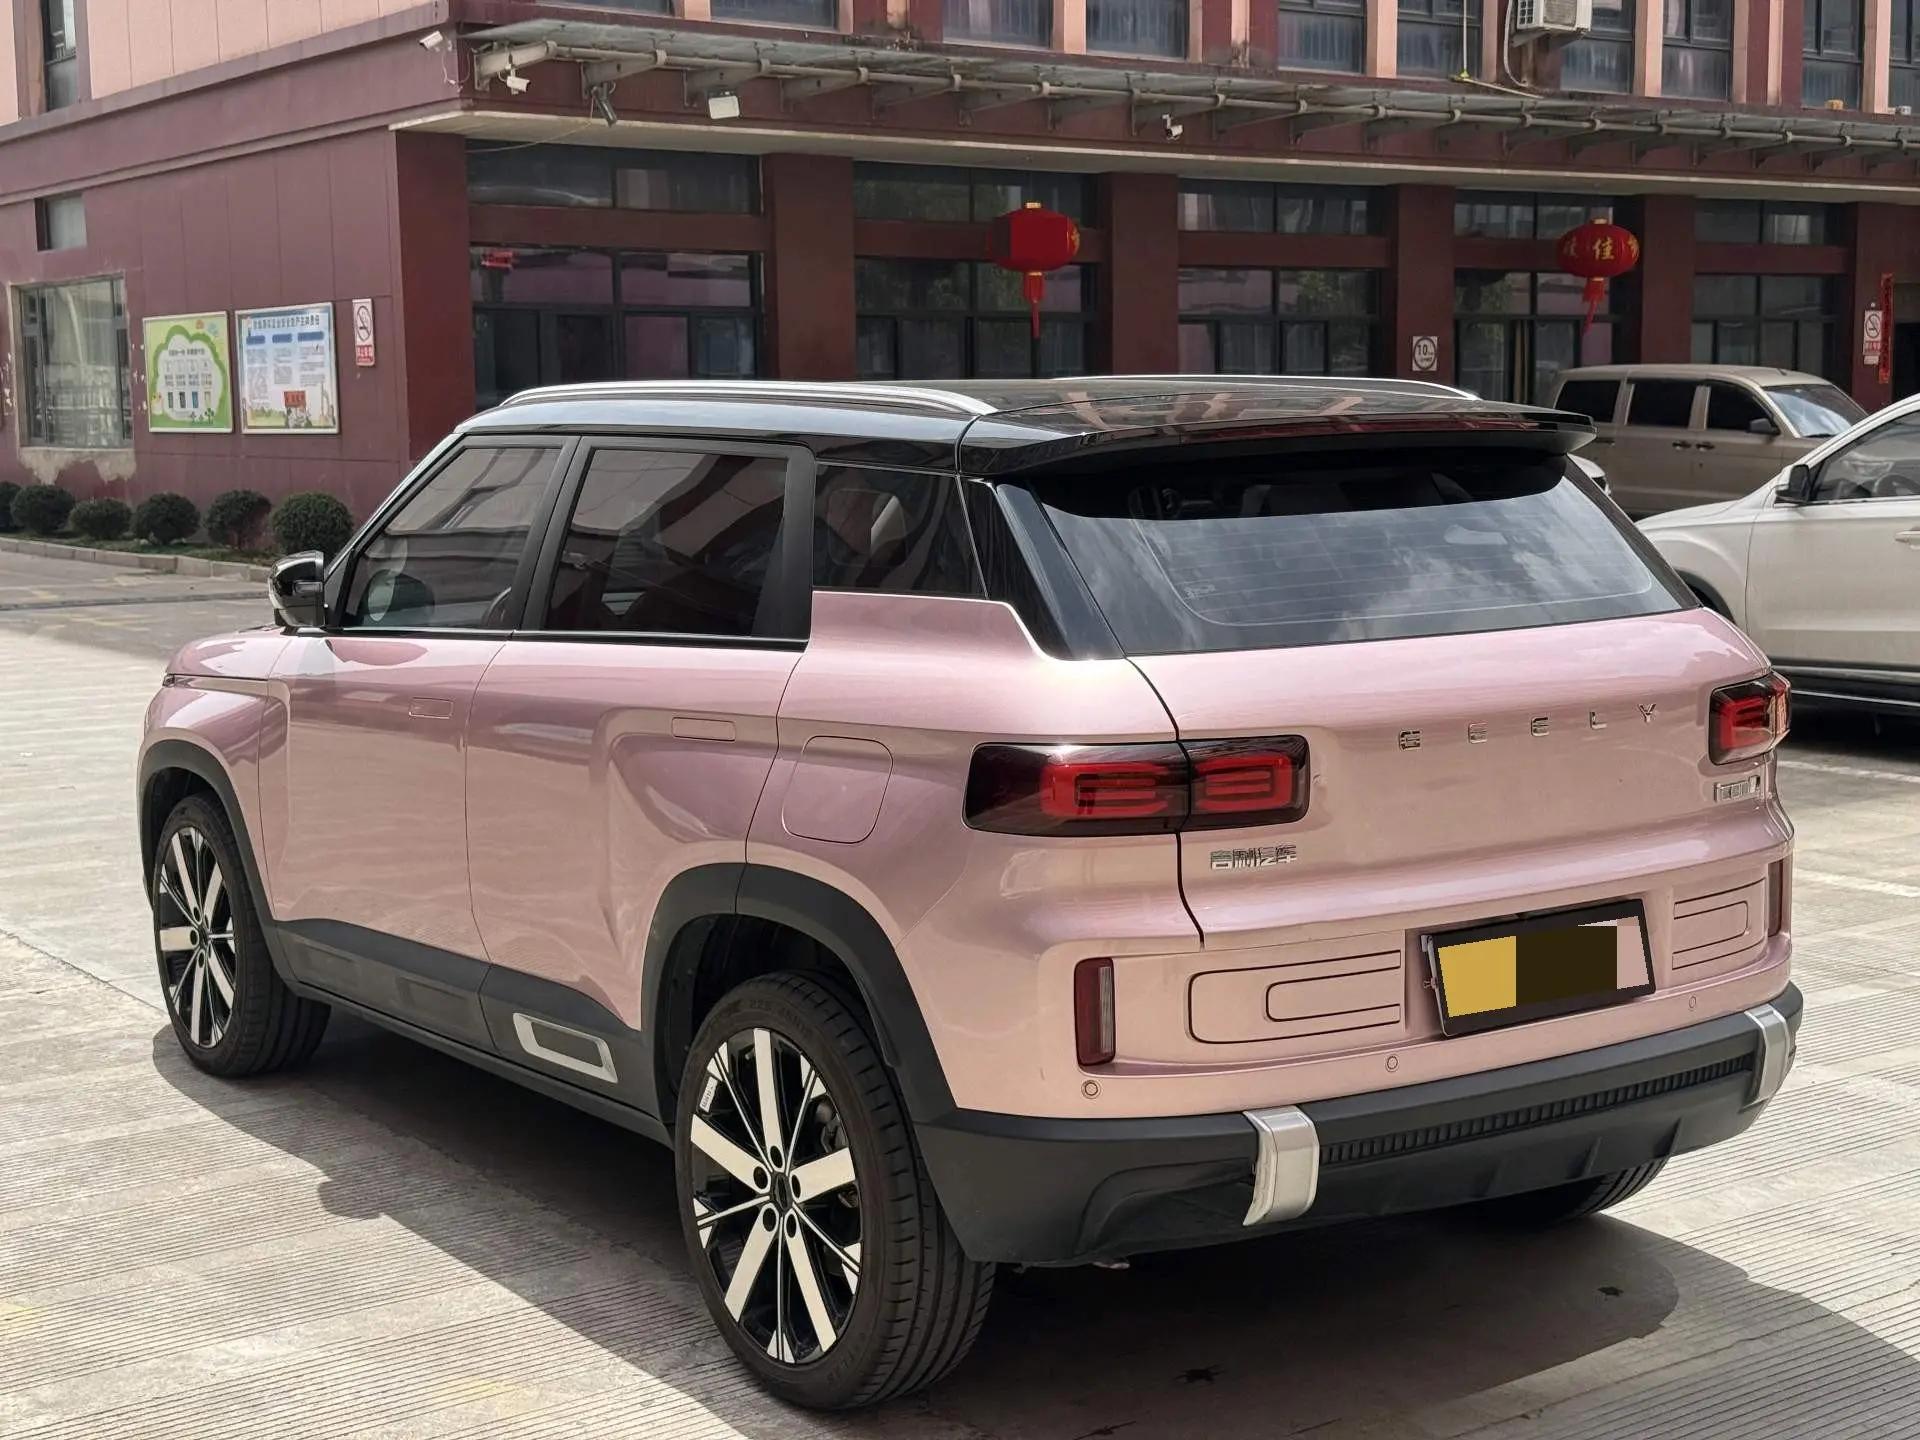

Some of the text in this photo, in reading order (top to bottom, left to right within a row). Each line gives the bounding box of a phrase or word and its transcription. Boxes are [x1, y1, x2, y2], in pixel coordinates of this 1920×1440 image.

[1592, 235, 1615, 261] 佳
[1416, 344, 1428, 356] 10
[1398, 703, 1657, 751] GEELY
